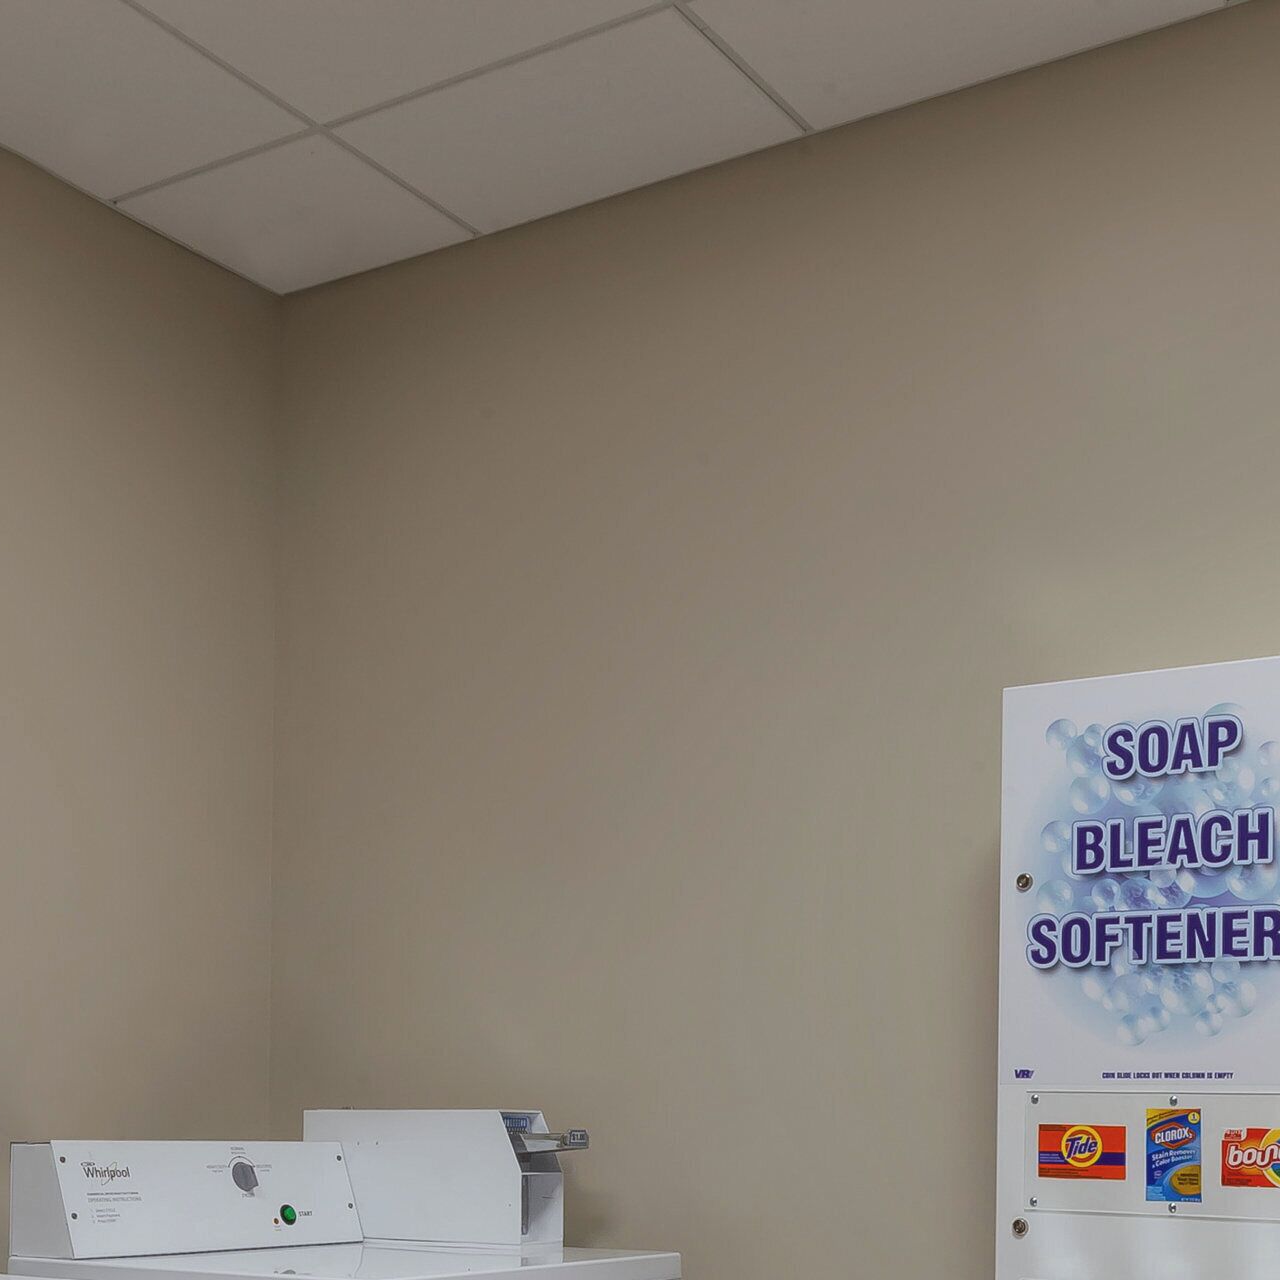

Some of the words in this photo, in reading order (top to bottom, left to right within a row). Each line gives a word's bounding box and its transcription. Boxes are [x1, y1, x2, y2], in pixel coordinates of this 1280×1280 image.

[1105, 717, 1240, 776] SOAP
[1075, 810, 1271, 872] BLEACH
[1133, 1071, 1150, 1079] LOCKS
[1164, 1071, 1180, 1079] WHEN
[1214, 1071, 1234, 1079] EMPTY
[1065, 1135, 1098, 1160] Tide
[1152, 1152, 1168, 1161] Stain
[1156, 1157, 1171, 1167] Color
[83, 1166, 131, 1181] Whirlpool
